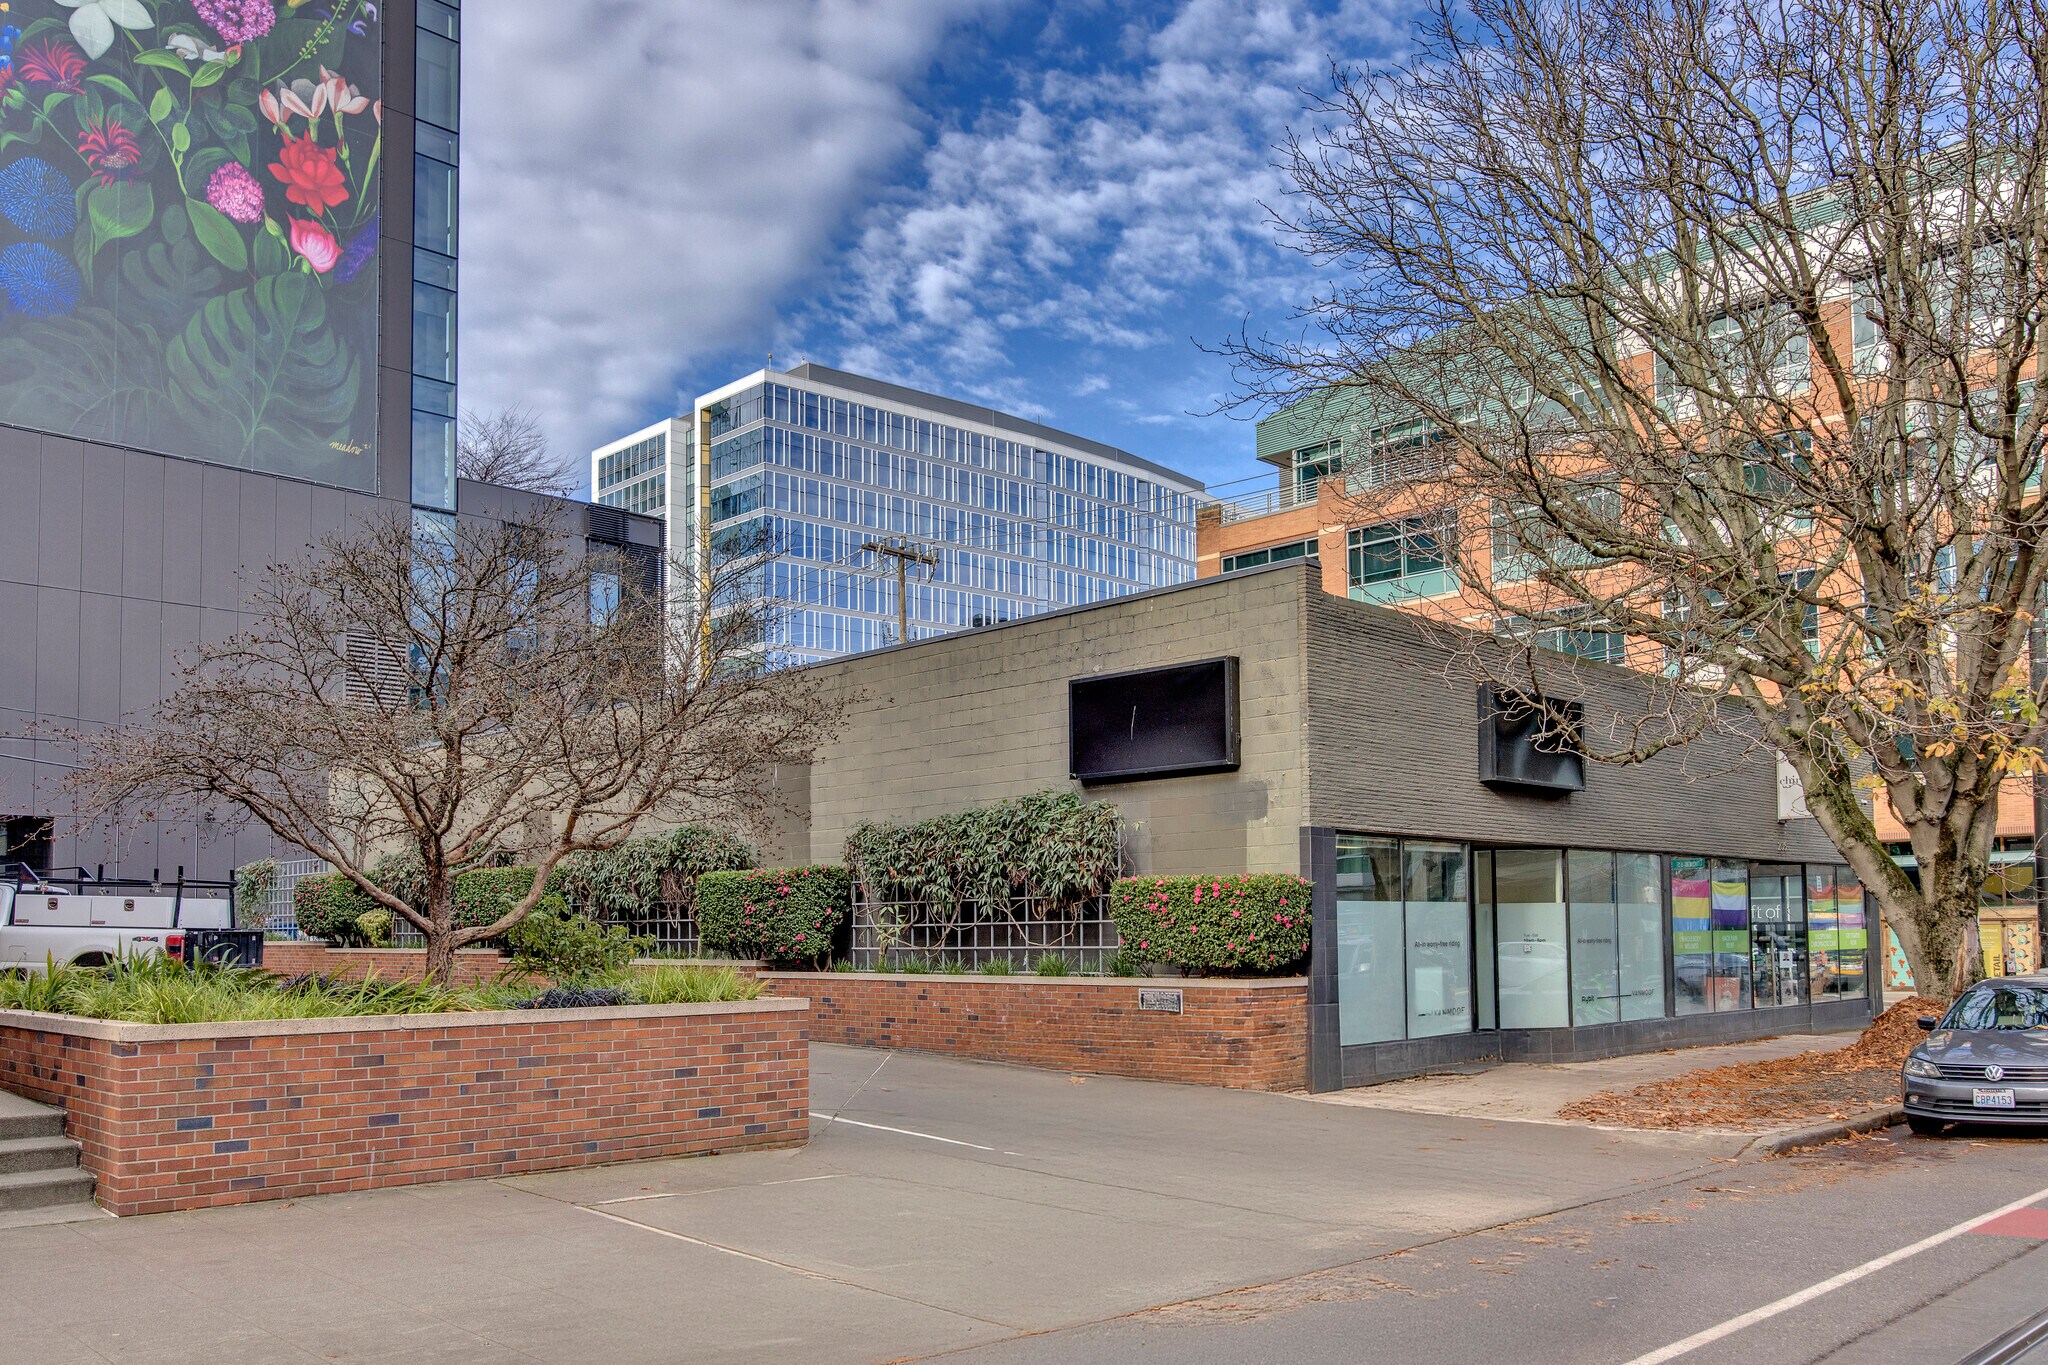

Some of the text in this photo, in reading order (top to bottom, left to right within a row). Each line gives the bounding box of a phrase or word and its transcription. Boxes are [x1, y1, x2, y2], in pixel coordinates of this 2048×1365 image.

[1765, 904, 1781, 919] of
[1993, 954, 2001, 977] ETAIL
[1975, 1095, 2013, 1105] CBP4153
